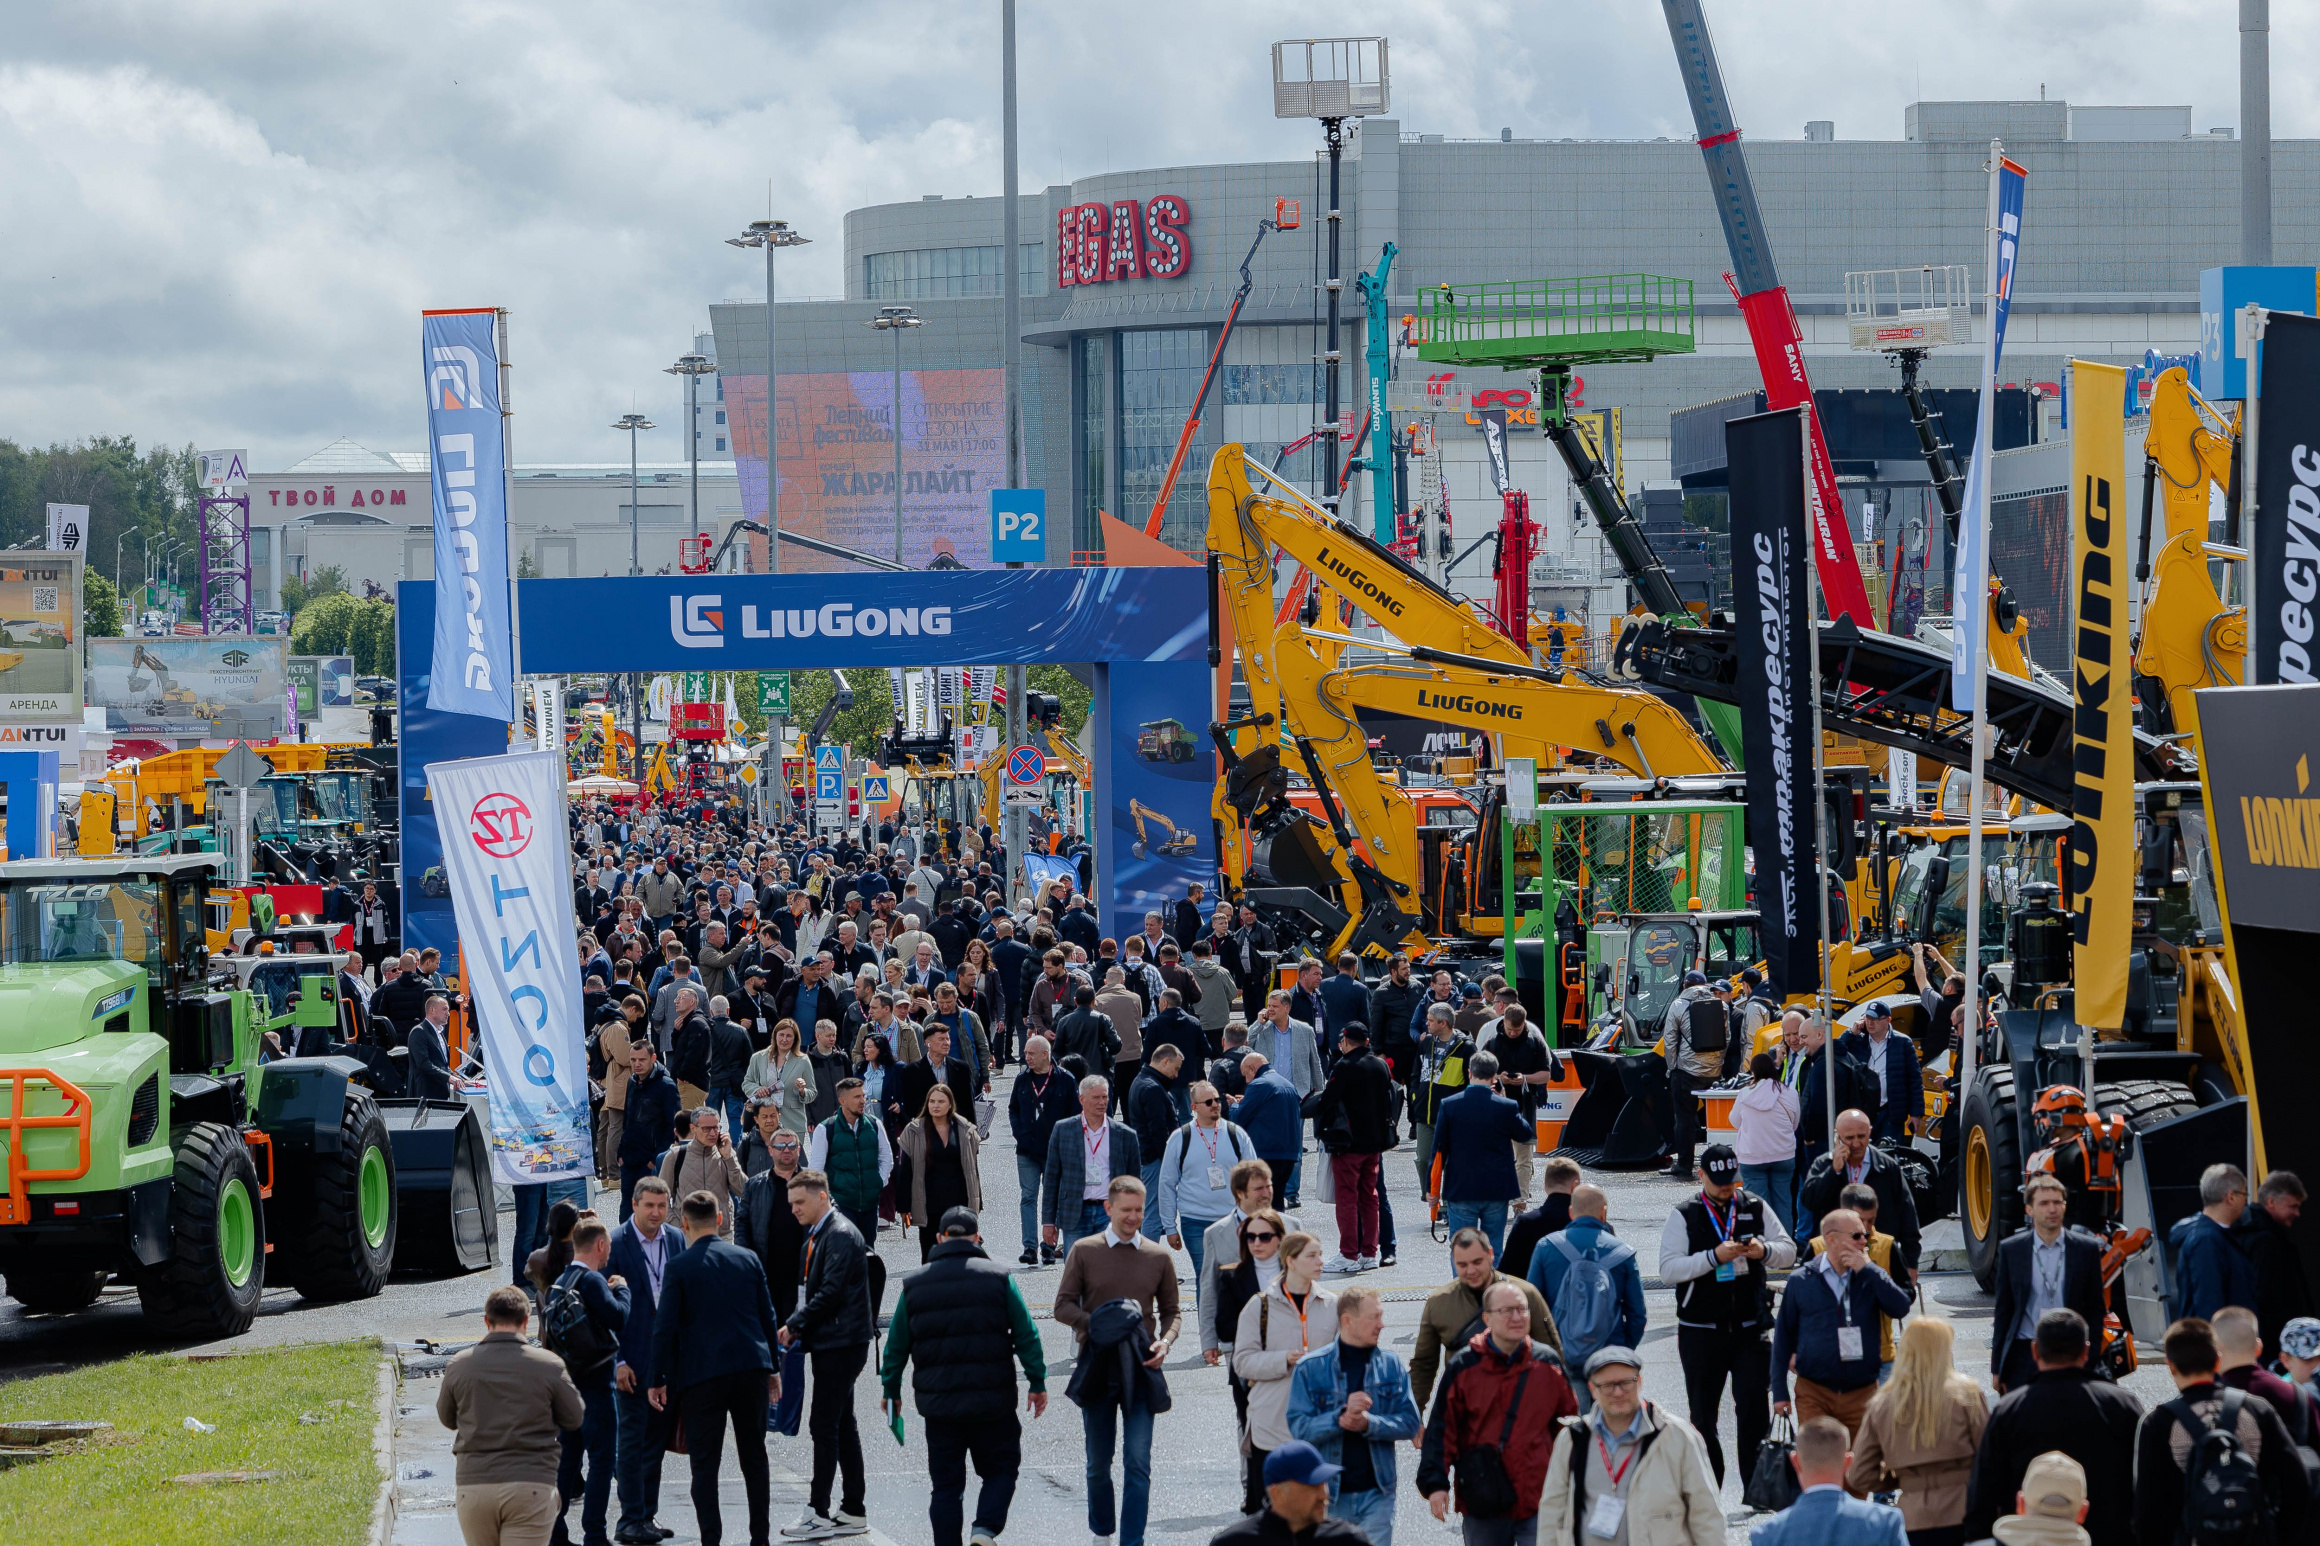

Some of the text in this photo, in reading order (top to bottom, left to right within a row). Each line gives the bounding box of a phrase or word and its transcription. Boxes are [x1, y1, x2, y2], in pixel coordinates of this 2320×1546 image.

[1057, 195, 1191, 288] EGAS
[2202, 312, 2220, 362] P3
[1784, 343, 1803, 383] SANY
[1371, 377, 1384, 432] SUNWARD
[906, 463, 976, 495] ЛАЙТ
[269, 486, 406, 507] ТВОЙ ДОМ
[998, 511, 1040, 541] P2
[214, 675, 258, 684] HYUNDAI
[892, 678, 902, 706] КВИНТ
[941, 673, 952, 703] КВИНТ
[971, 668, 985, 700] КВИНТ
[9, 700, 58, 711] АРЕНДА
[821, 776, 835, 796] P
[26, 885, 110, 903] TZCO
[1710, 1160, 1725, 1172] GO
